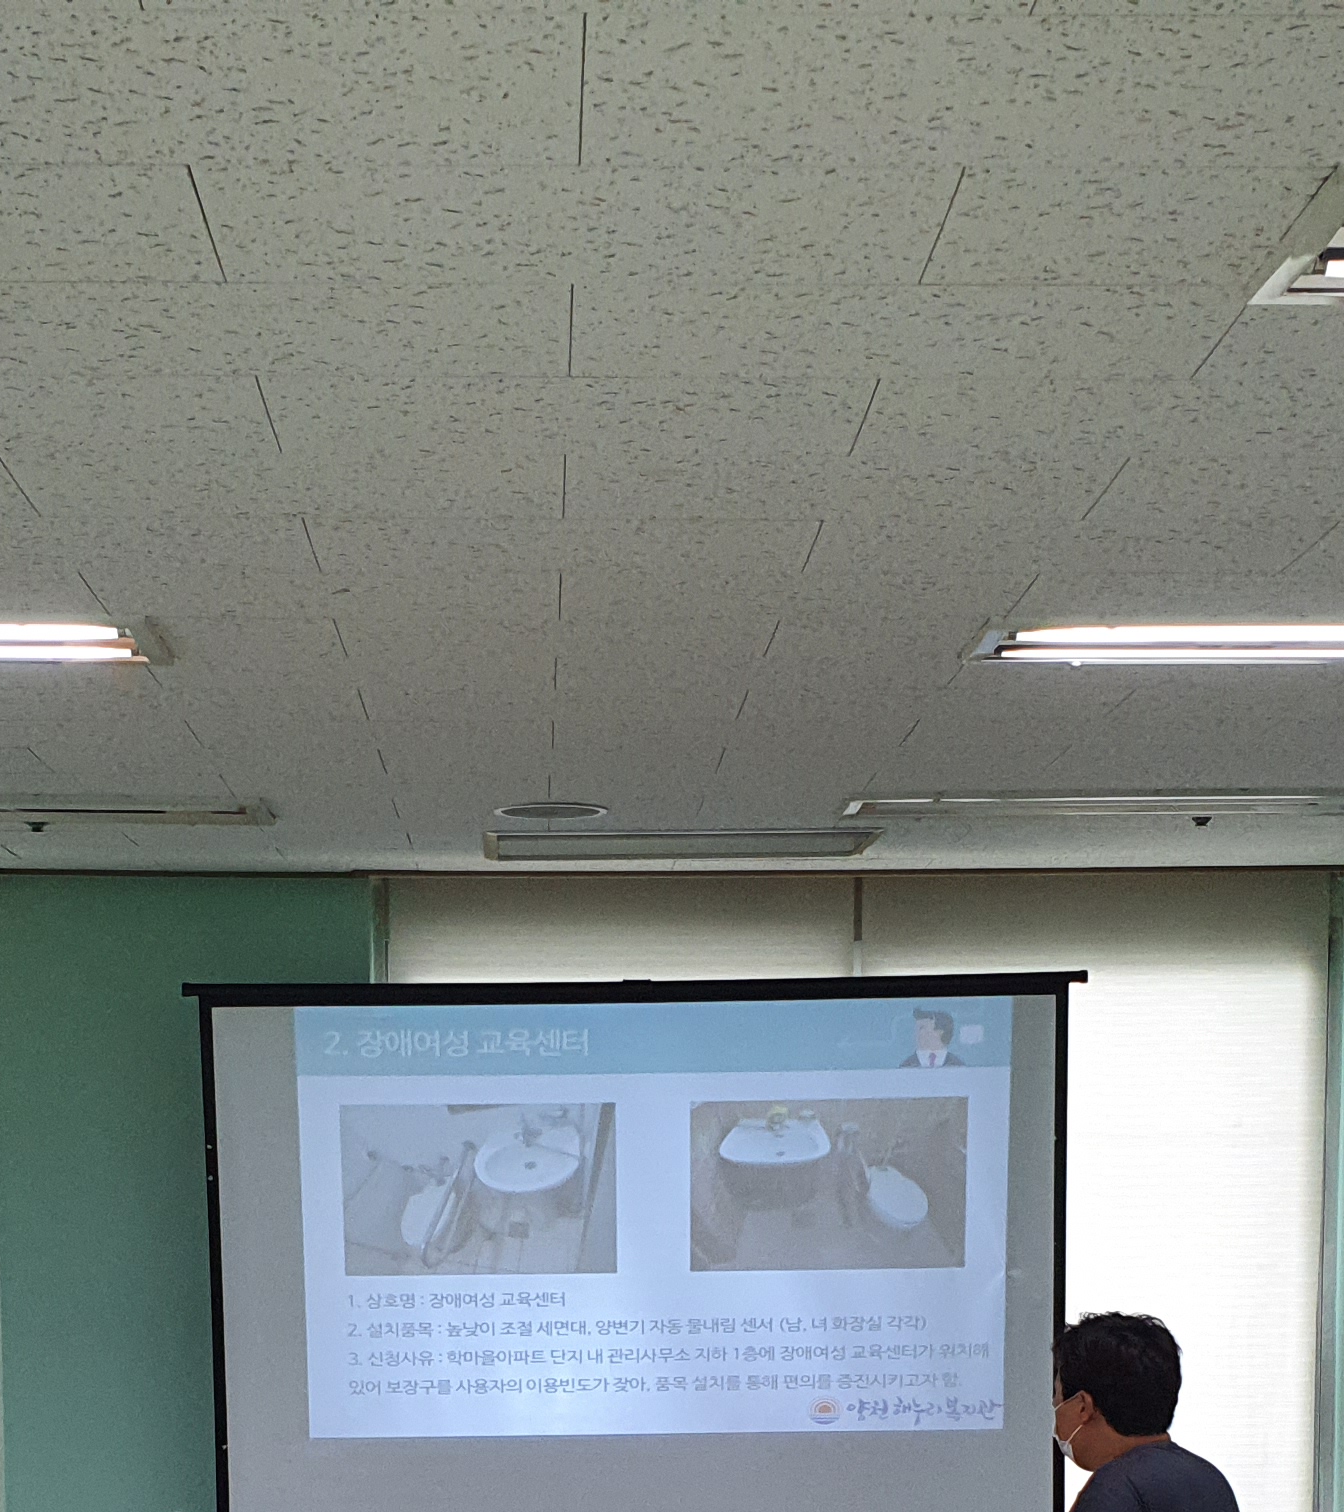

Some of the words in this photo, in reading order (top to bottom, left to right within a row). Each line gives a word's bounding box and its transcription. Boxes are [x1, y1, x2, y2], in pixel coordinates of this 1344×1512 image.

[325, 1031, 348, 1055] 2.
[358, 1029, 469, 1058] 장애여성
[478, 1028, 589, 1057] 교육센터
[367, 1292, 416, 1310] 상호명
[429, 1292, 495, 1309] 장애여성
[499, 1291, 566, 1308] 교육센터
[366, 1322, 433, 1339] 설치품목
[445, 1321, 496, 1338] 높낮이
[500, 1321, 534, 1338] 조절
[595, 1319, 645, 1336] 양변기
[649, 1318, 683, 1335] 자동
[686, 1317, 736, 1335] 물내림
[740, 1316, 774, 1333] 센서
[811, 1315, 828, 1332] 녀
[832, 1315, 883, 1332] 화장실
[368, 1351, 435, 1367] 신청사유
[447, 1349, 547, 1366] 학마을아파트
[550, 1348, 583, 1365] 단지
[587, 1347, 604, 1365] 내
[607, 1346, 691, 1364] 관리사무소
[695, 1346, 728, 1363] 지하
[733, 1345, 775, 1362] 1층에
[780, 1344, 846, 1362] 장애여성
[850, 1343, 935, 1361] 교육센터가
[938, 1341, 990, 1360] 위치해
[349, 1379, 382, 1396] 있어
[385, 1378, 452, 1396] 보장구를
[456, 1378, 523, 1395] 사용자의
[526, 1377, 610, 1394] 이용빈도가
[655, 1375, 688, 1392] 품목
[691, 1374, 742, 1392] 설치를
[746, 1374, 779, 1391] 통해
[783, 1373, 832, 1391] 편의를
[837, 1372, 939, 1390] 증진시키고자
